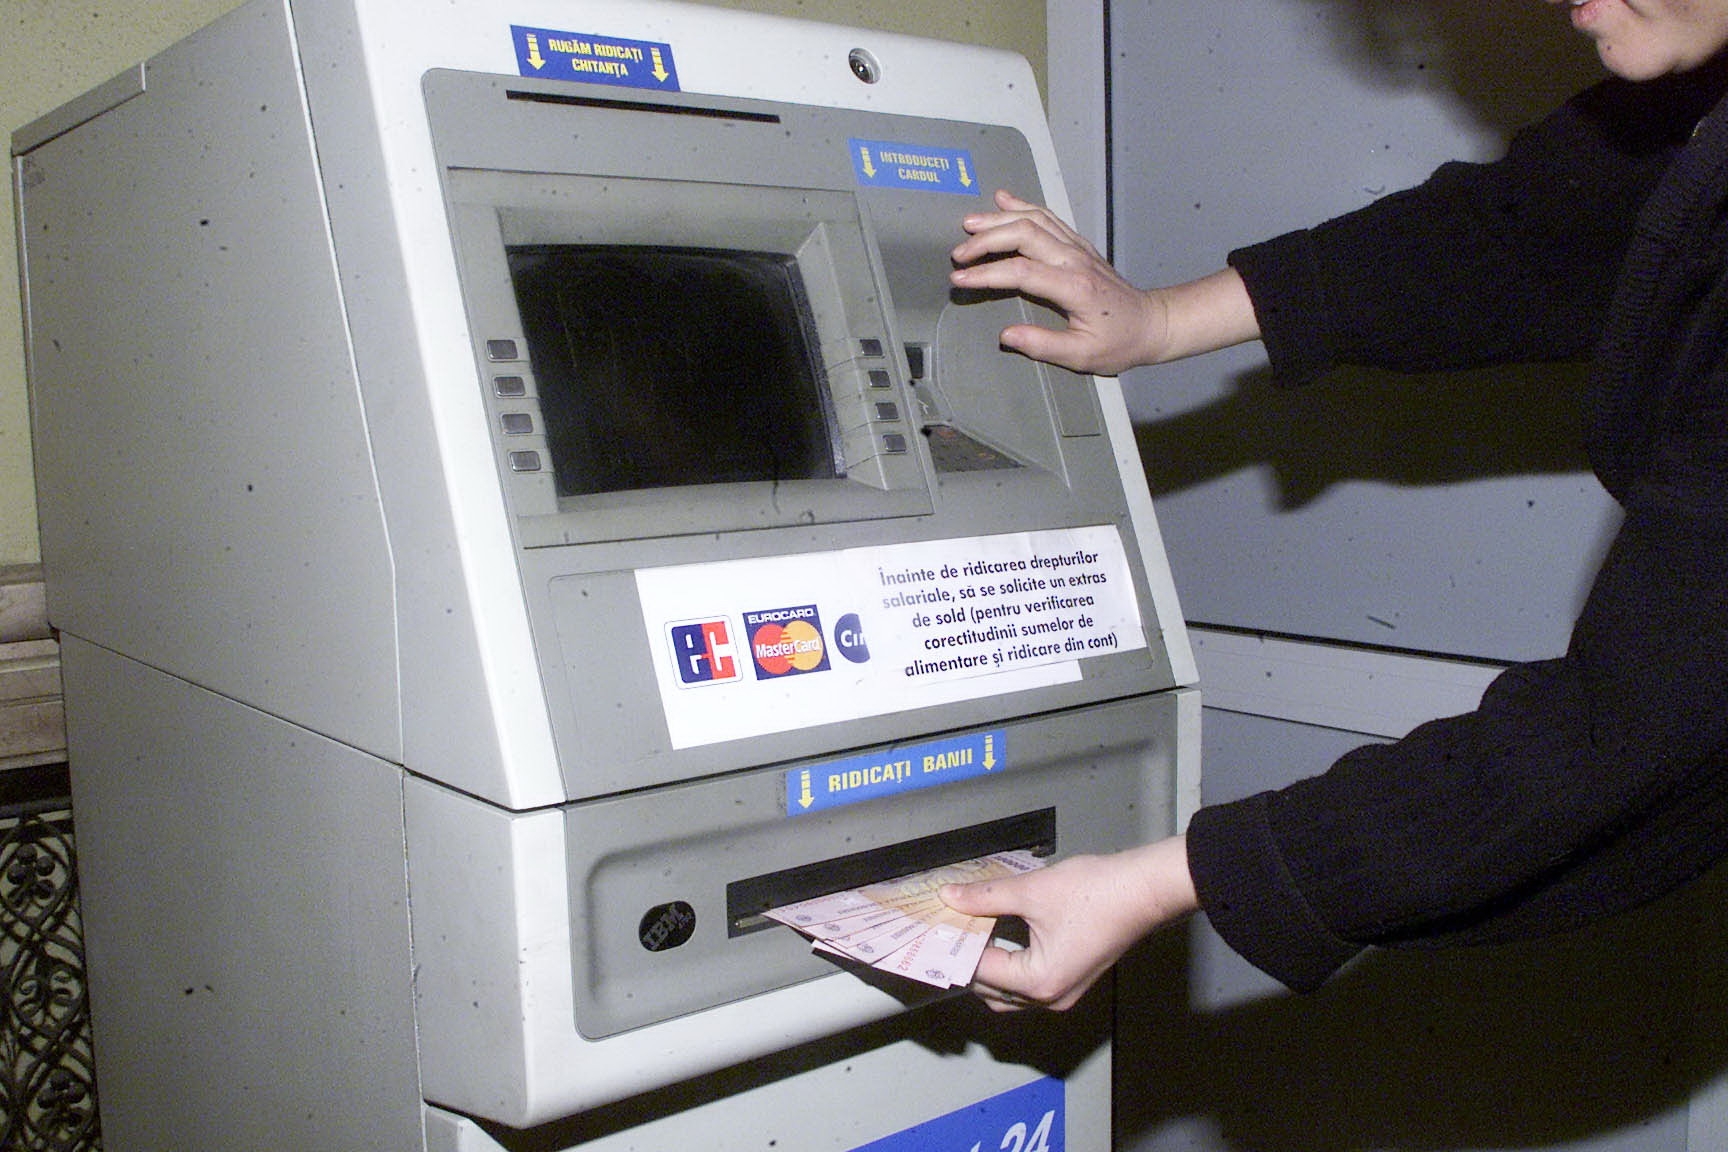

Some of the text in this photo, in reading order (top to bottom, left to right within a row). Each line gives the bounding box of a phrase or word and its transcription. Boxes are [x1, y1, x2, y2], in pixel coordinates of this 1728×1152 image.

[898, 168, 941, 183] CARDUL
[940, 564, 959, 579] de
[963, 558, 1027, 576] ridicarea
[1030, 551, 1099, 572] drepturilor
[883, 571, 1107, 609] salariale, să se solicite un extras
[747, 608, 814, 625] EUROCARD
[912, 595, 1095, 628] de sold (pentru verificarea
[924, 614, 1094, 650] corectitudinii sumelor de
[755, 637, 821, 659] MasterCard
[904, 651, 988, 677] alimentare
[1007, 641, 1061, 661] ridicare
[1064, 638, 1085, 653] din
[1087, 631, 1119, 649] cont)
[923, 748, 973, 773] BANII
